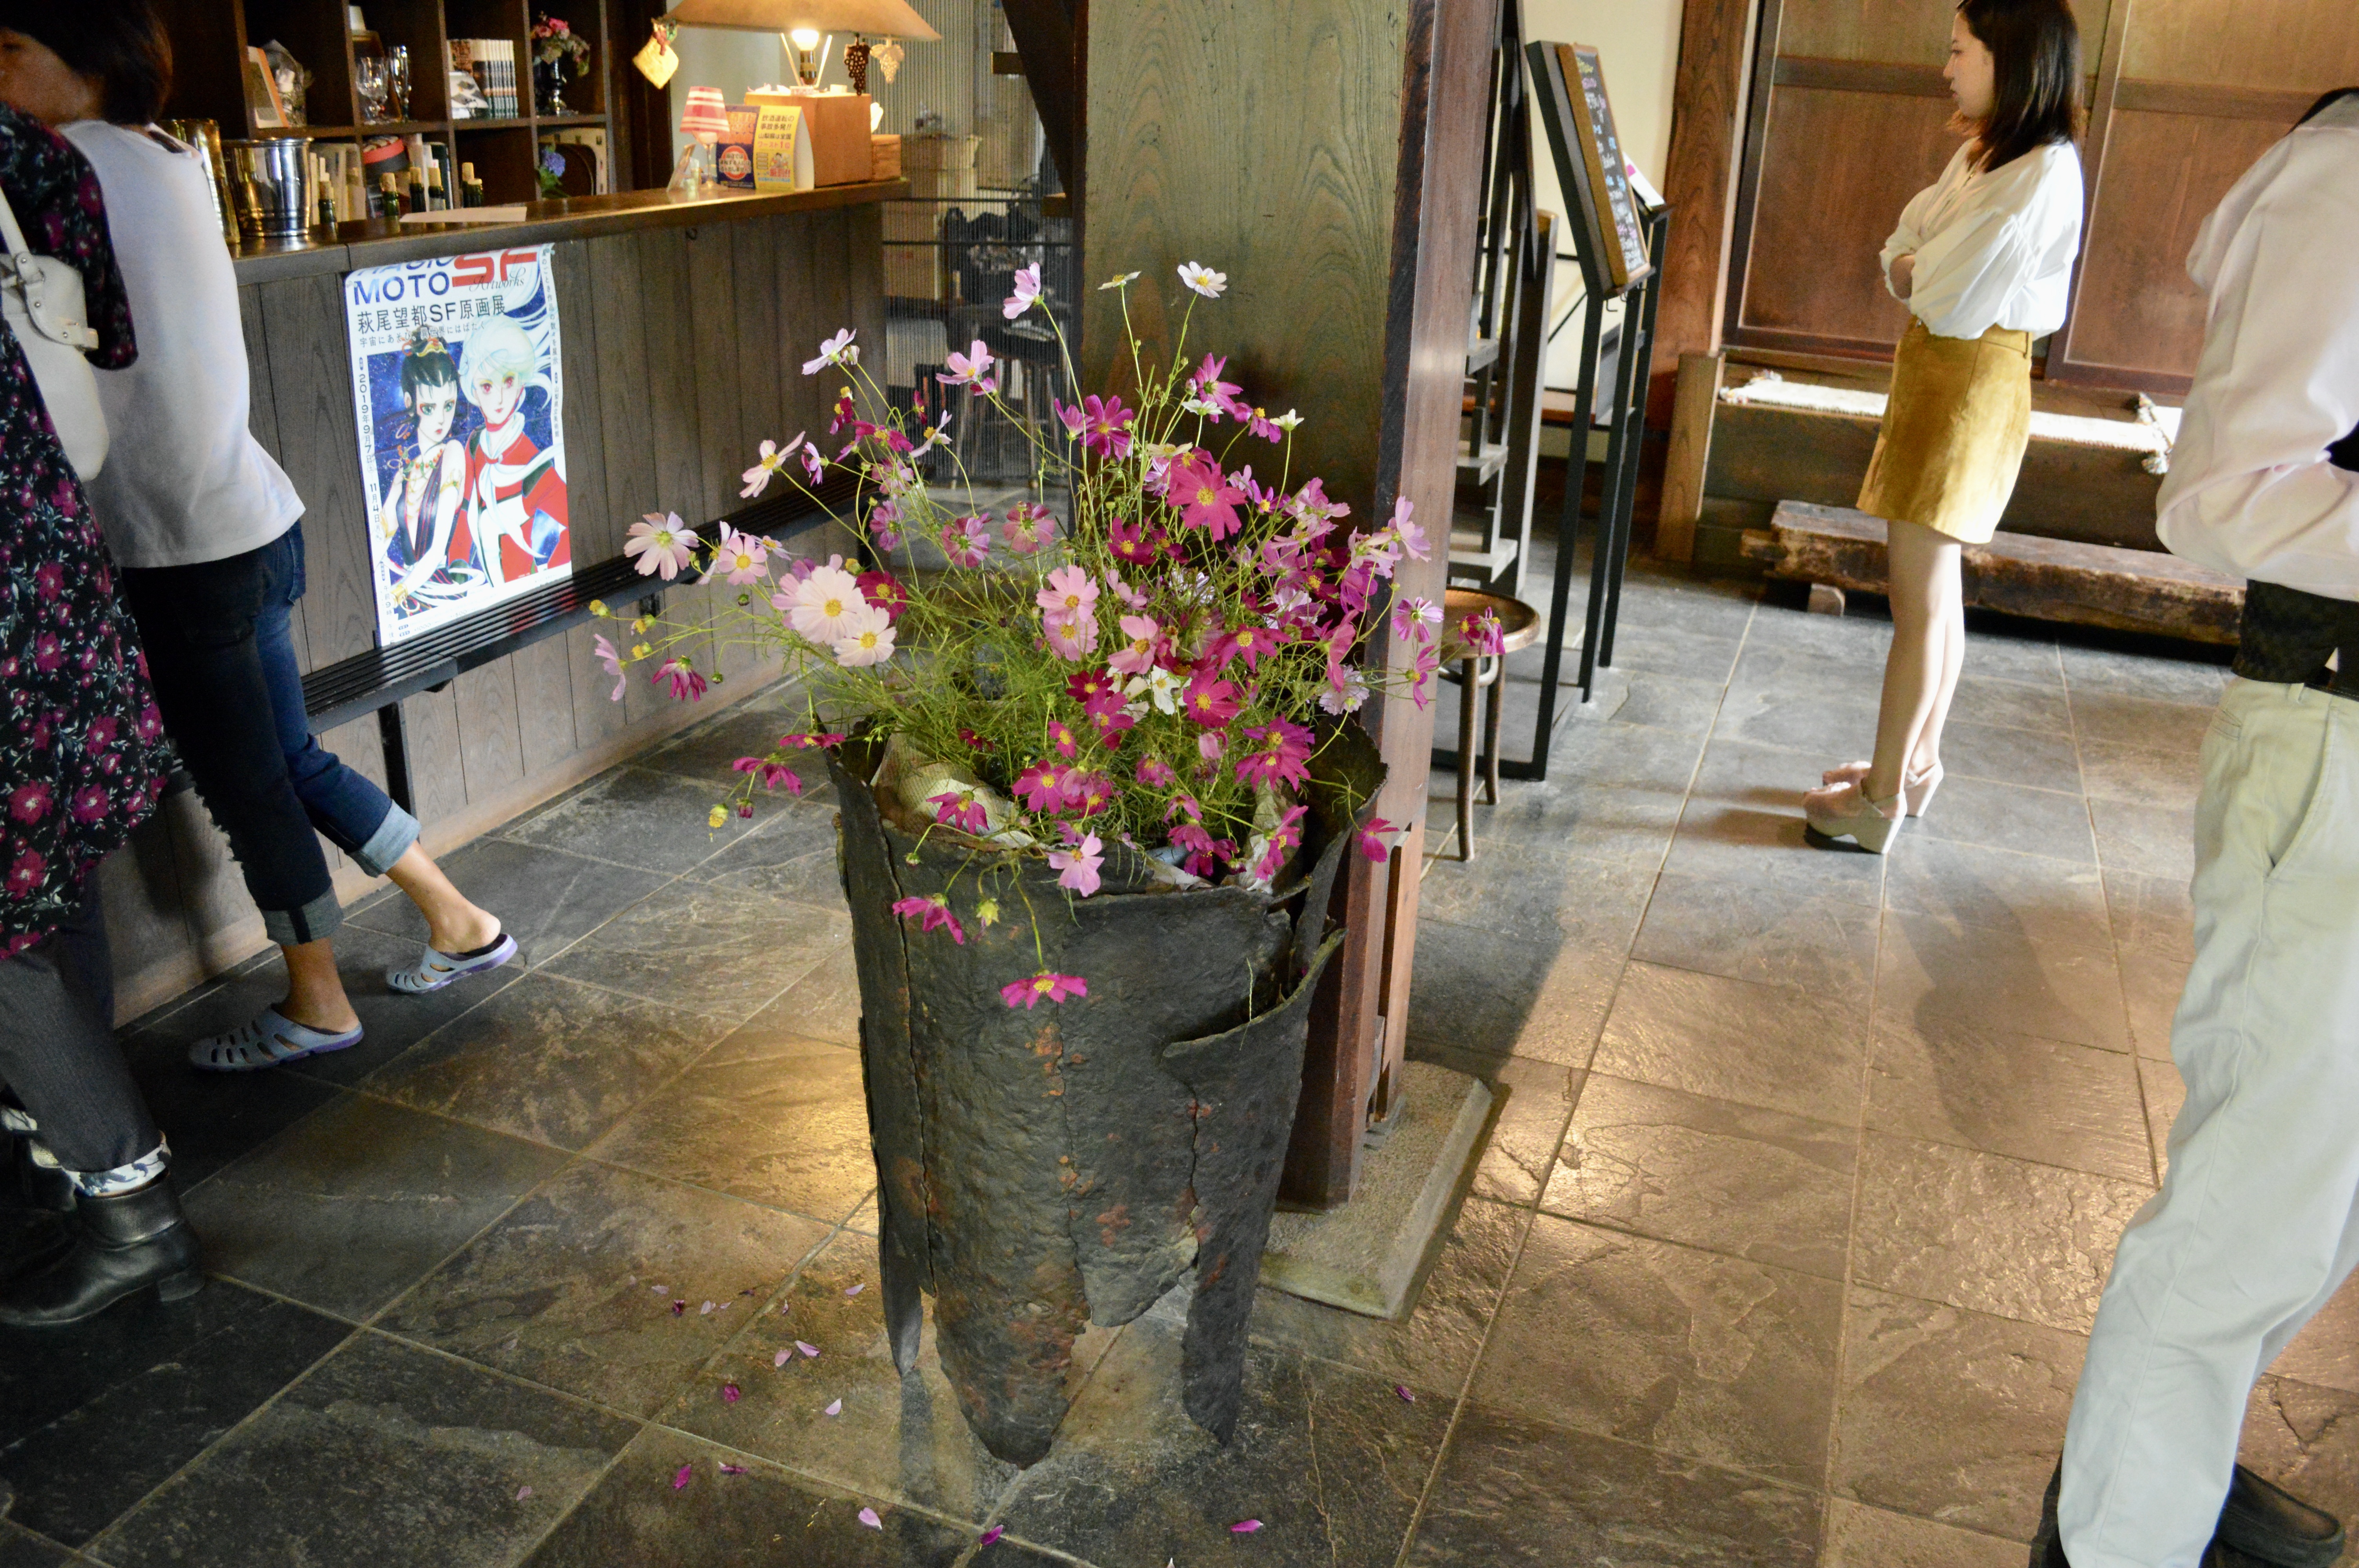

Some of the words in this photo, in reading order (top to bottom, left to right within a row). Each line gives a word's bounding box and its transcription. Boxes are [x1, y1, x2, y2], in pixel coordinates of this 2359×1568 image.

[452, 250, 537, 287] SF
[469, 267, 525, 292] Artworks
[354, 271, 450, 305] MOTO
[357, 295, 505, 334] 萩尾望都SF原画展
